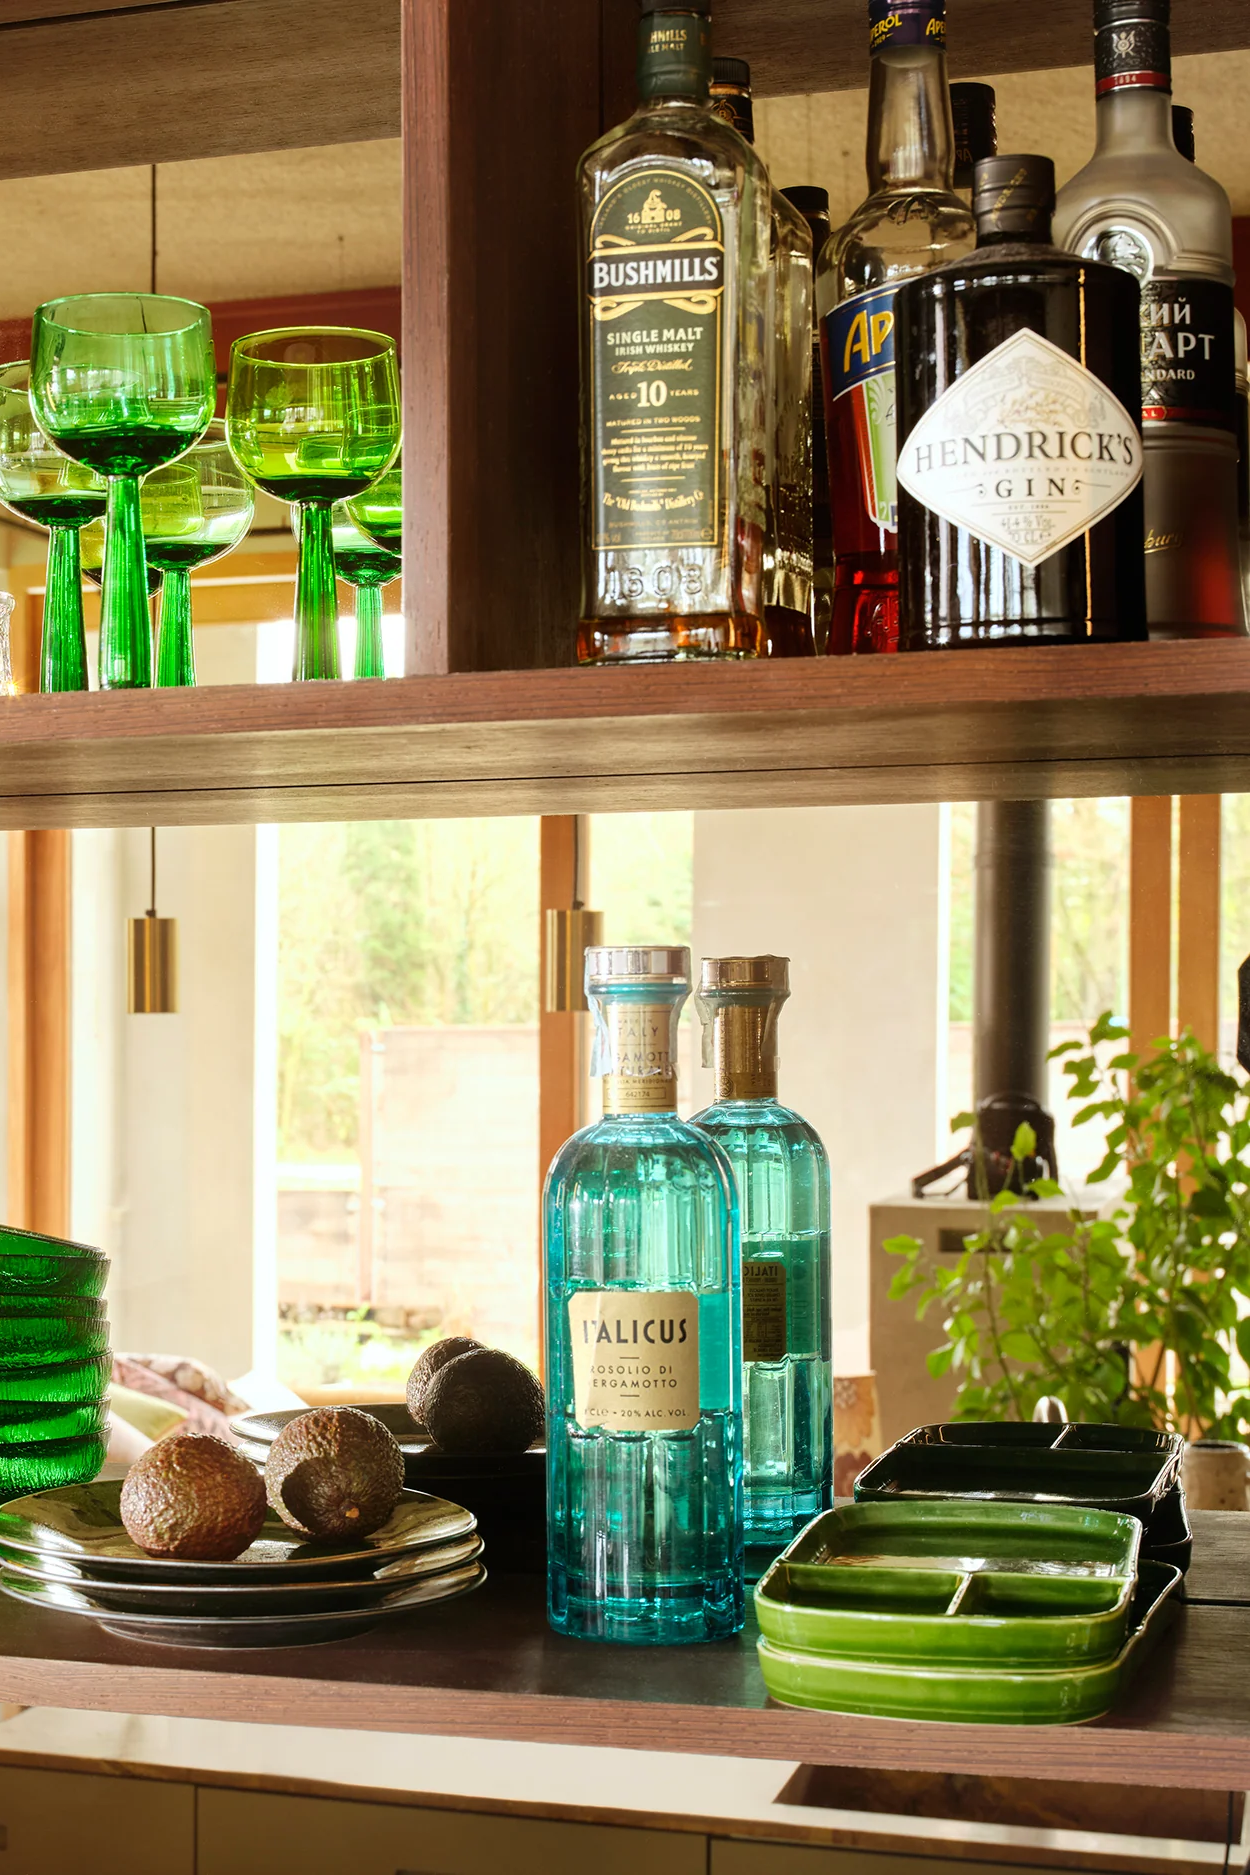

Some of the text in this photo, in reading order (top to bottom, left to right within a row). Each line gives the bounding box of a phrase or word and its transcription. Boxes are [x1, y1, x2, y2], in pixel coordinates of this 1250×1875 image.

[627, 209, 681, 224] 16 08
[593, 257, 718, 288] BUSHMILLS
[607, 327, 703, 345] SINGLE MALT
[615, 342, 694, 356] IRISH WHISKEY
[1141, 331, 1215, 360] АРТ
[1141, 369, 1195, 380] NDARD
[609, 380, 699, 407] AGED 10 YEARS
[915, 430, 1134, 474] HENDRICK'S
[996, 478, 1066, 498] GIN
[616, 1027, 659, 1037] TALY
[583, 1318, 688, 1344] ITALICUS
[590, 1365, 673, 1375] ROSOLIO DI
[592, 1379, 678, 1388] ERGAMOTTO
[621, 1409, 690, 1418] 20% ALC. VOL.
